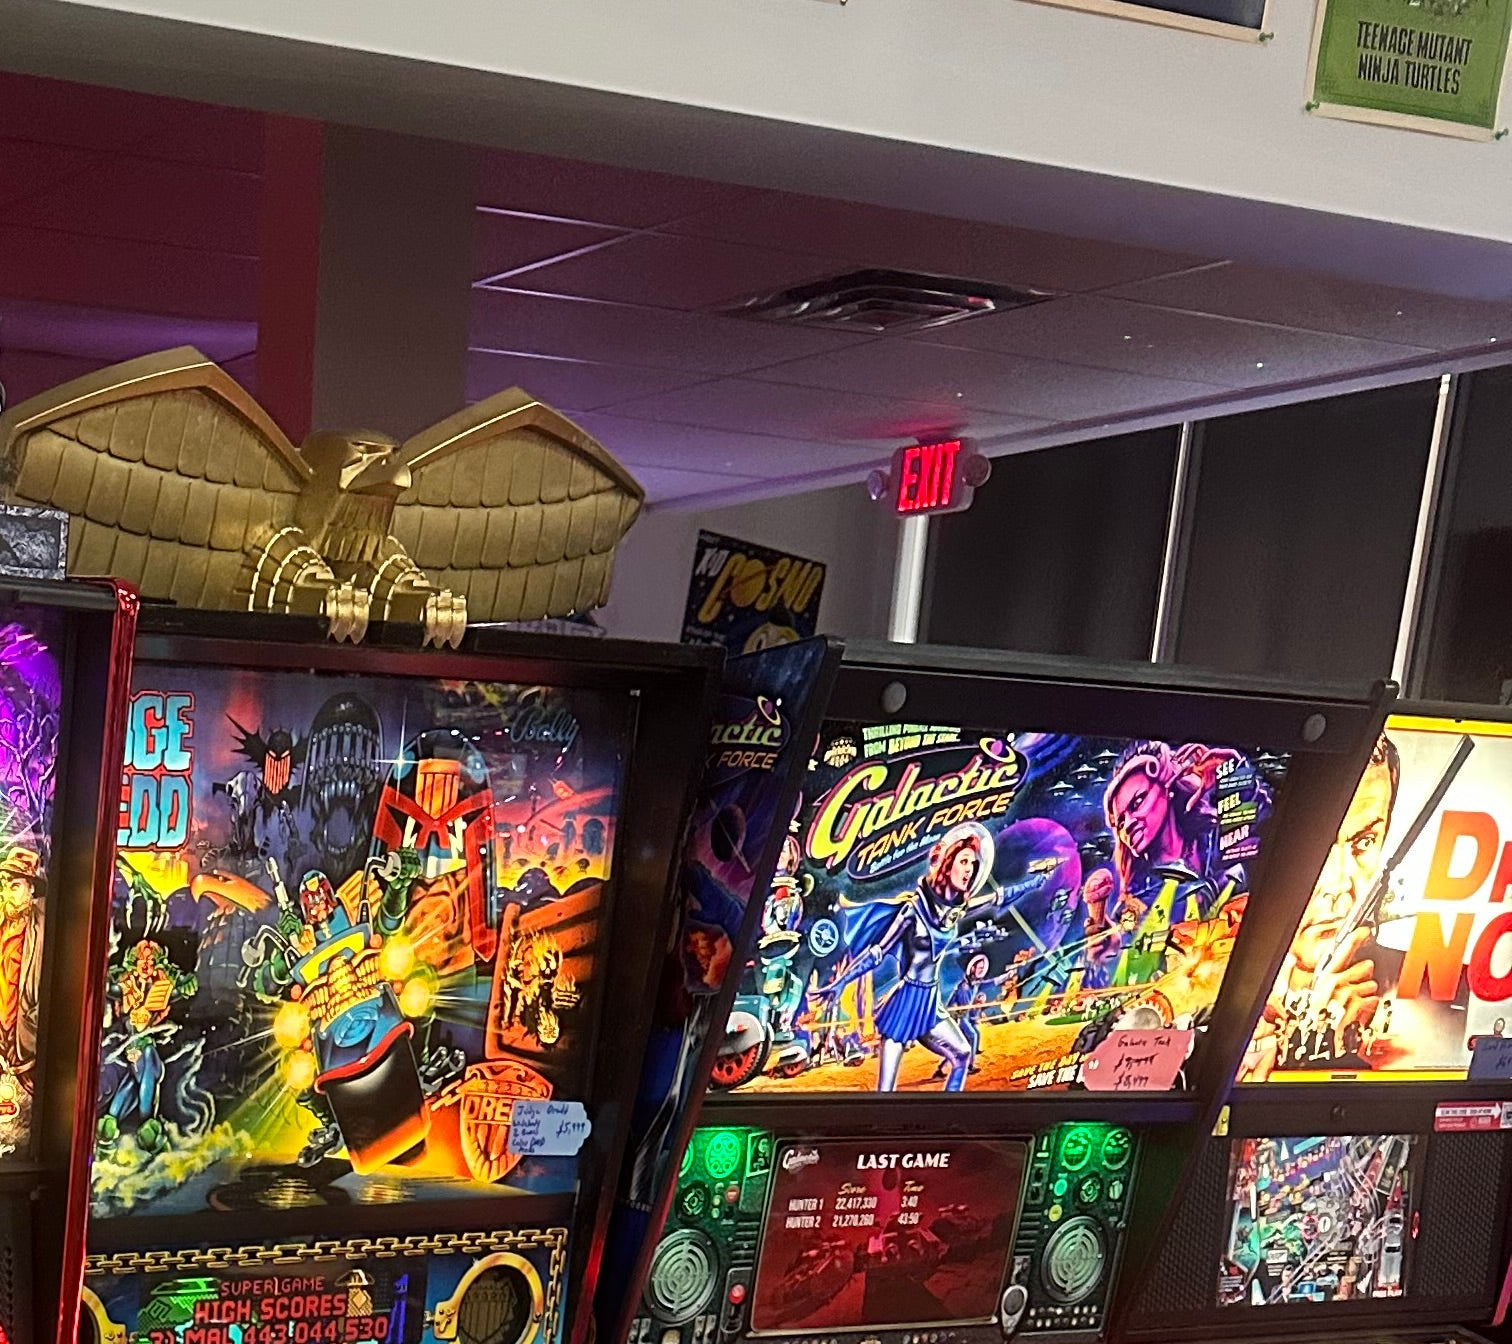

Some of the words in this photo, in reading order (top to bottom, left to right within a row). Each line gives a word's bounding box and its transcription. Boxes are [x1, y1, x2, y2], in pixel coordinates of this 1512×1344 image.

[1357, 20, 1415, 56] TEENAGE
[1417, 31, 1472, 66] MUTANT
[1358, 53, 1399, 85] NINJA
[1405, 60, 1460, 95] TURTLES
[897, 441, 960, 512] EXIT
[509, 703, 581, 746] Bally
[720, 751, 778, 769] FORCE
[1216, 758, 1234, 780] SEE
[807, 754, 1018, 868] Galactic
[1218, 792, 1241, 815] FEEL
[857, 818, 926, 871] TANK
[927, 791, 1016, 834] FORCE
[1220, 825, 1249, 851] HEAR
[1027, 1070, 1055, 1090] SAVE
[1057, 1065, 1078, 1084] THE
[857, 1154, 899, 1169] LAST
[902, 1153, 950, 1168] GAME
[789, 1199, 817, 1212] HUNTER
[785, 1217, 815, 1229] HUNTER
[815, 1217, 821, 1228] 2
[221, 1279, 273, 1297] SUPER
[283, 1276, 324, 1291] GAME
[194, 1300, 251, 1324] HIGH
[261, 1294, 346, 1321] SCORES
